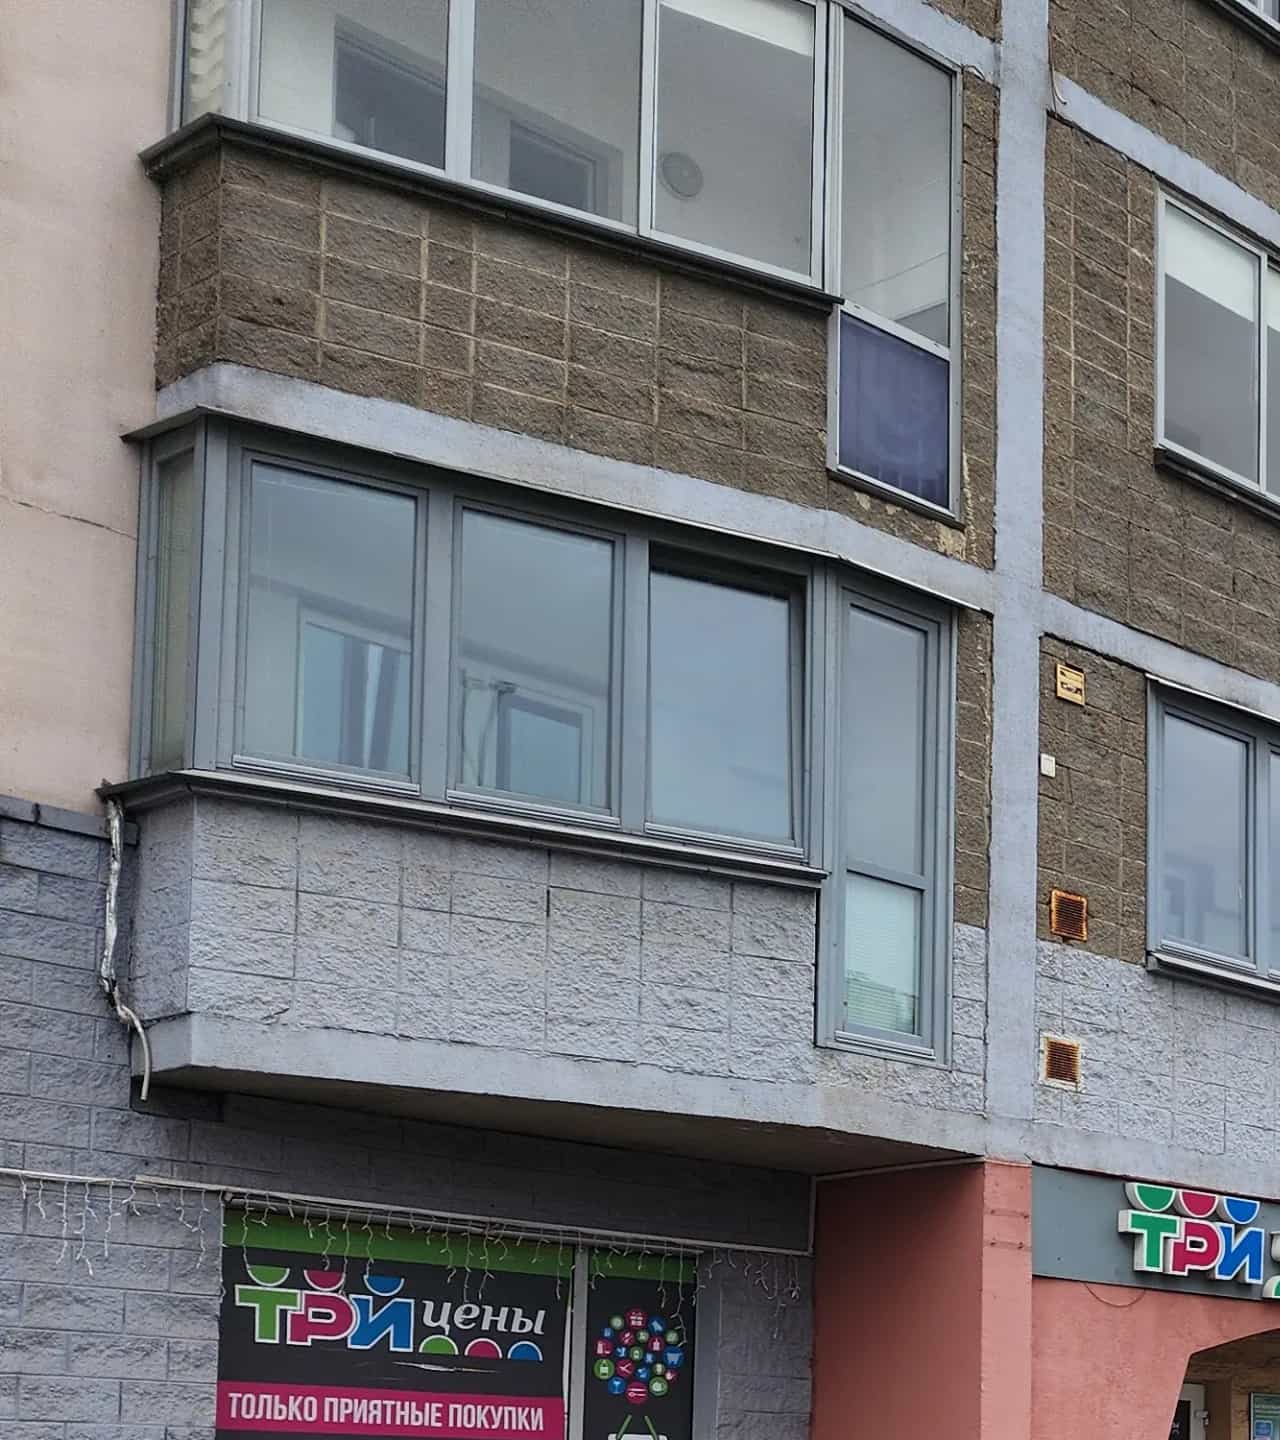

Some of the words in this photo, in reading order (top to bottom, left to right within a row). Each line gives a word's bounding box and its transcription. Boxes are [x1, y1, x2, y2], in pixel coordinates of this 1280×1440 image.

[1119, 1210, 1265, 1284] ТРИ
[235, 1284, 414, 1353] ТРИ
[422, 1300, 546, 1337] цены
[228, 1393, 318, 1423] ТОЛЬКО
[323, 1397, 443, 1428] ПРИЯТНЫЕ
[448, 1404, 545, 1431] ПОКУПКИ
